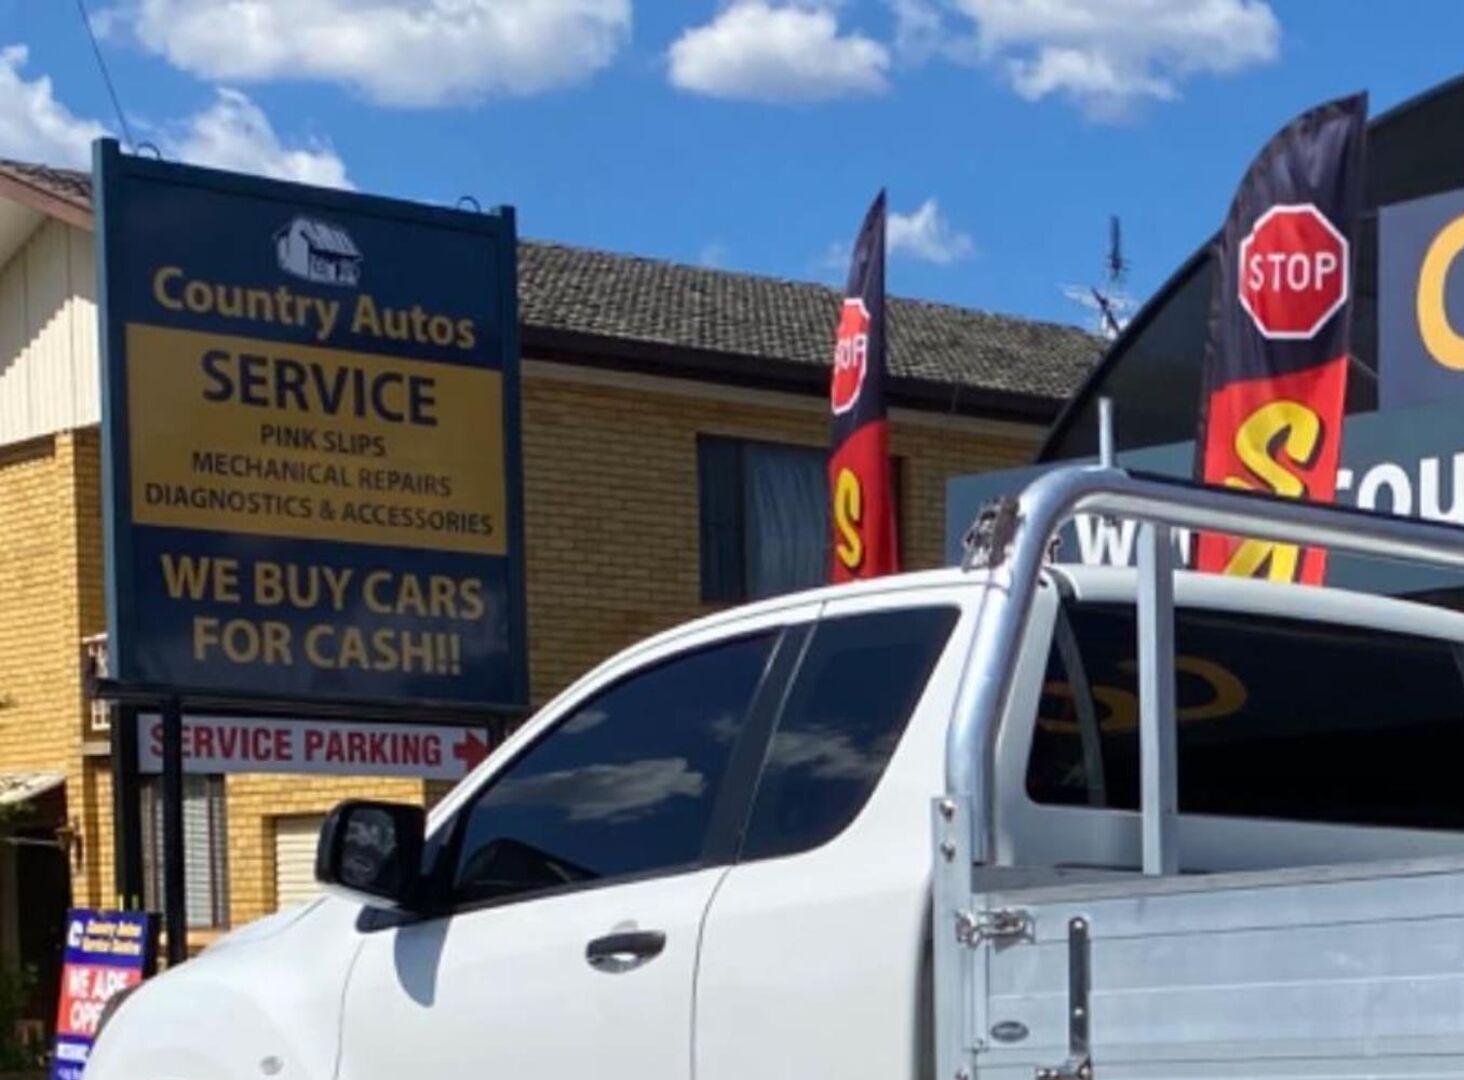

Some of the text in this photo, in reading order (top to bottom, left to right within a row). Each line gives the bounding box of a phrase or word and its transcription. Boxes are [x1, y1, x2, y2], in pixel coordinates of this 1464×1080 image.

[1248, 252, 1338, 292] STOP
[153, 266, 477, 349] Country Autos
[202, 350, 439, 427] SERVICE
[260, 423, 386, 458] PINK SLIPS
[191, 451, 452, 498] MECHANICAL REPAIRS
[144, 482, 494, 537] DIAGNOSTICS & ACCESSORIES
[160, 553, 486, 622] WE BUY CARS
[192, 615, 462, 676] FOR CASH!!
[304, 729, 442, 767] PARKING
